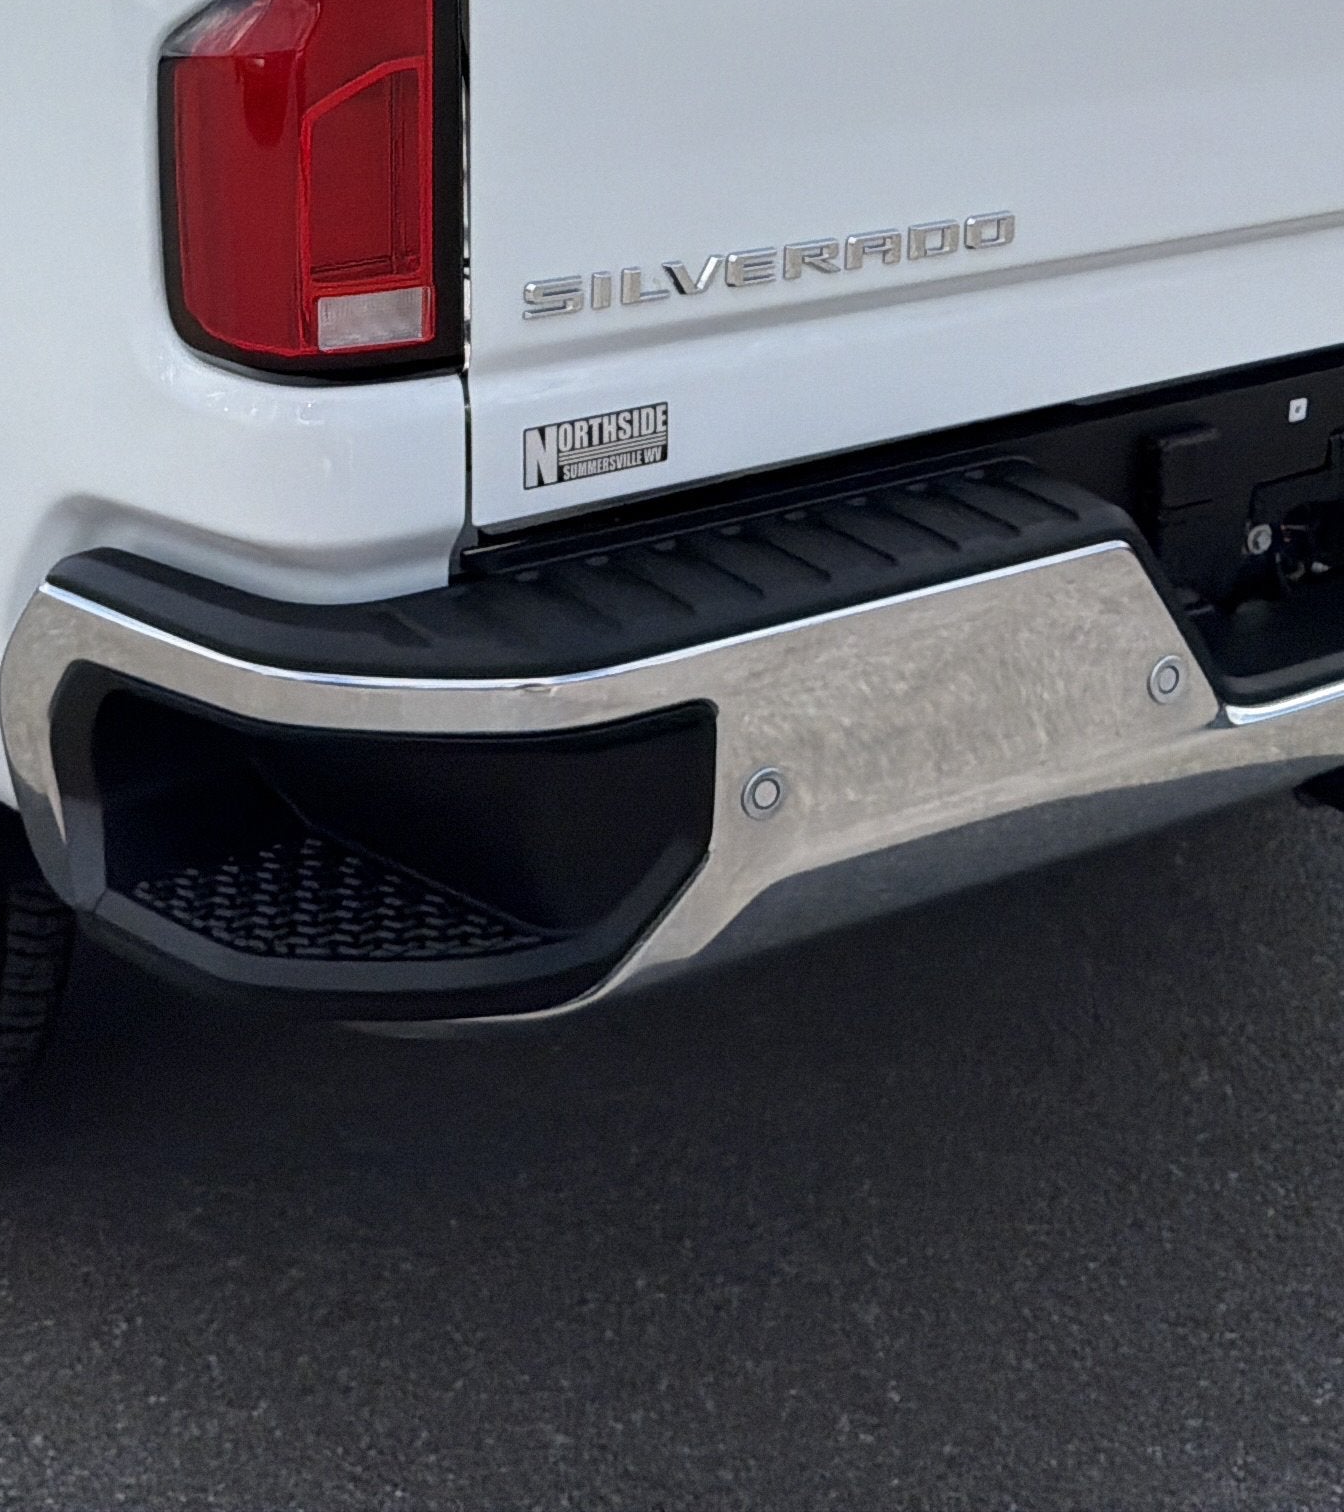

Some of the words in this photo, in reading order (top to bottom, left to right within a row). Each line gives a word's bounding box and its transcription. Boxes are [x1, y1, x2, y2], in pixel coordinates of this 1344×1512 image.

[522, 210, 1017, 320] SILVERADO
[525, 403, 668, 488] NORTHSIDE
[562, 450, 643, 481] SUMMERSVILLE
[643, 445, 663, 465] WV
